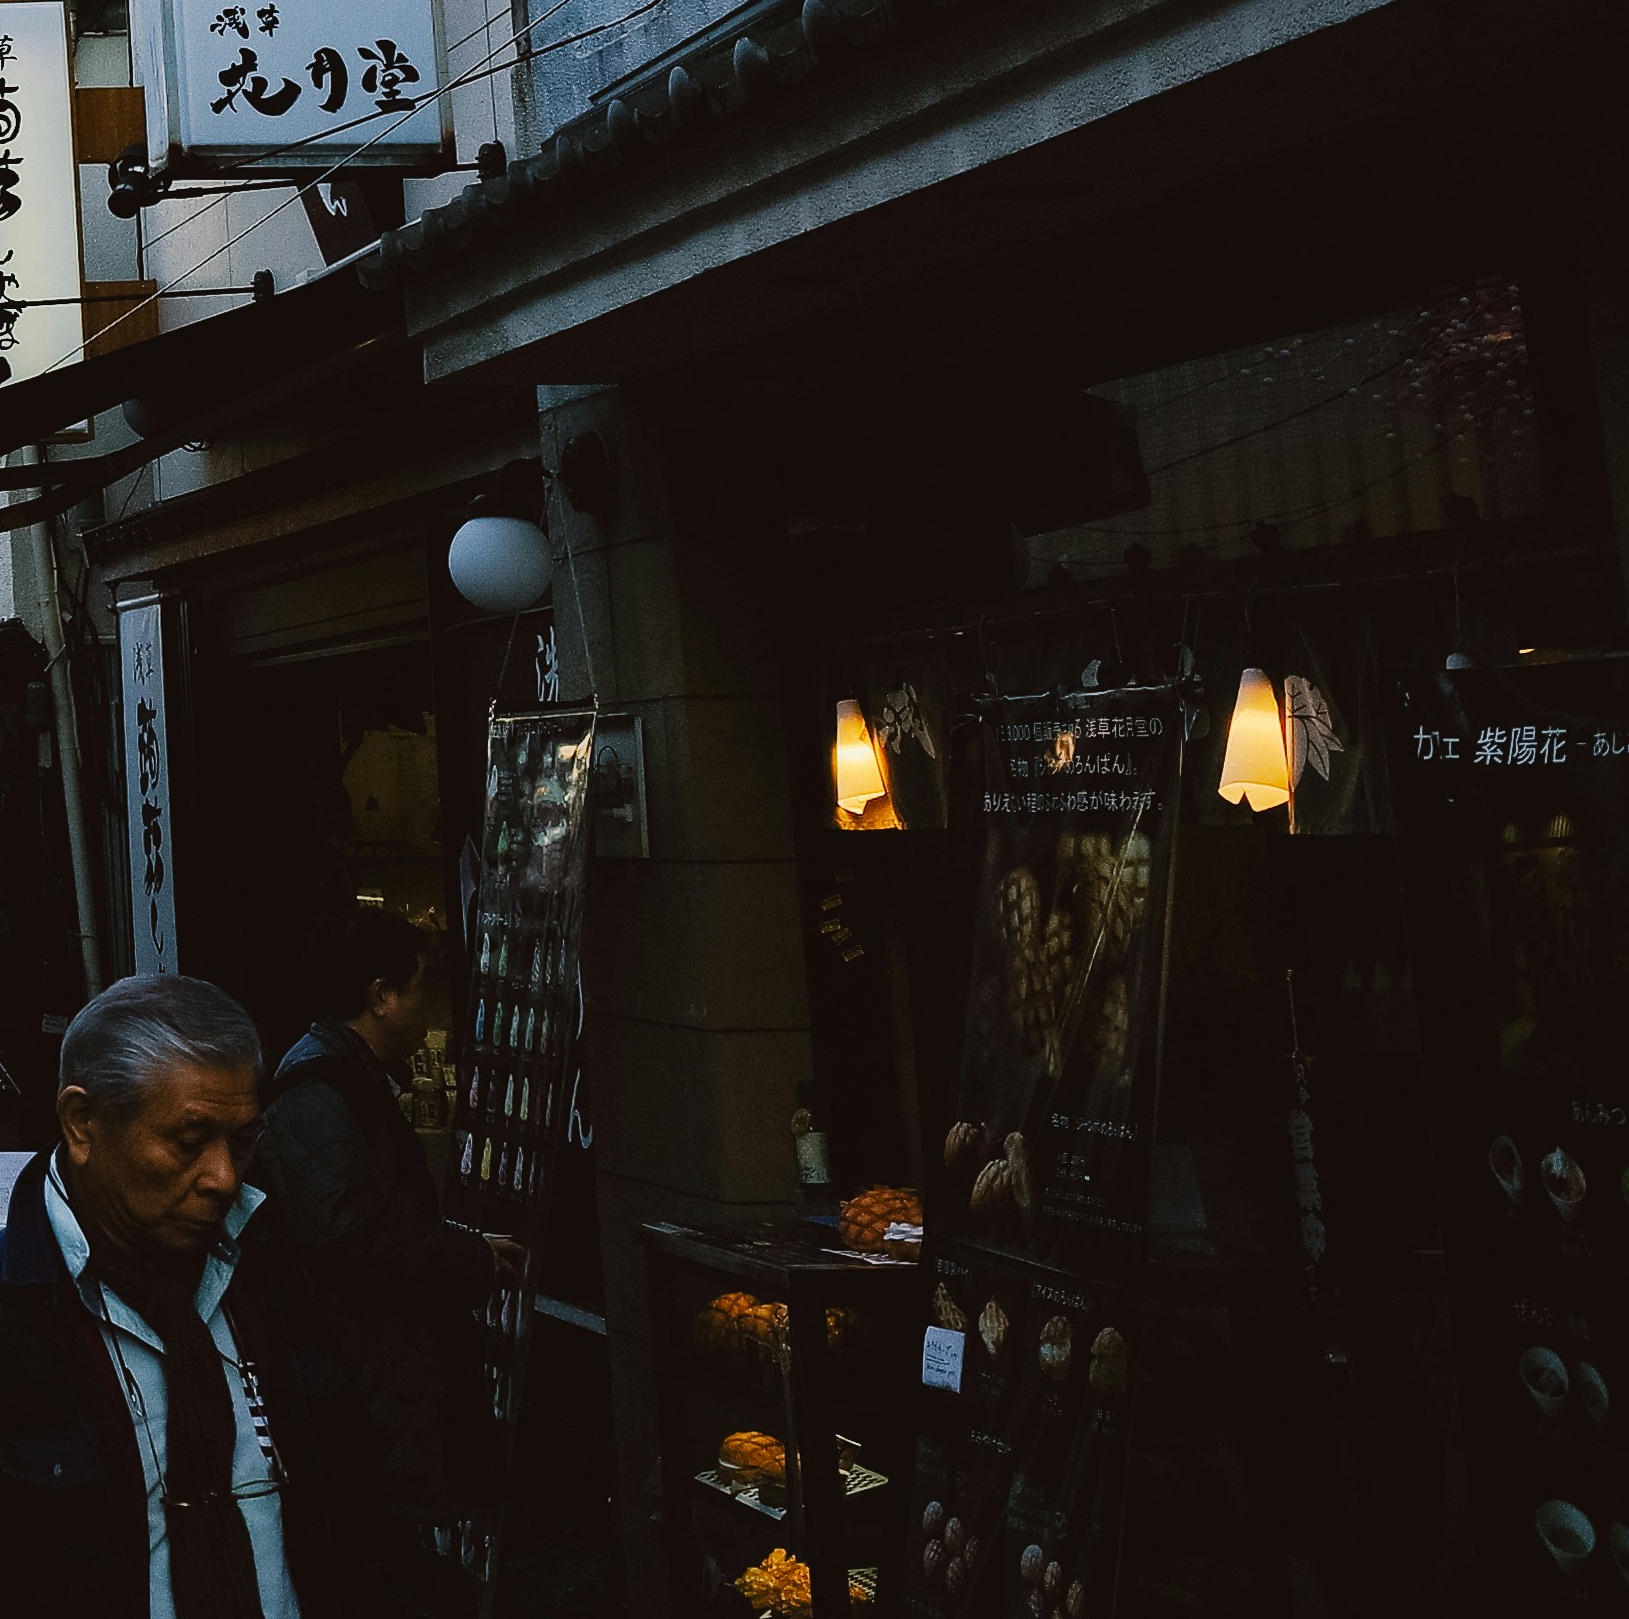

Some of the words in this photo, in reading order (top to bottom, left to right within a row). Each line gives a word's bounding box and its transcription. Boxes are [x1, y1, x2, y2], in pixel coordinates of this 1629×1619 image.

[211, 5, 282, 39] 浅草
[211, 40, 422, 118] 花月堂
[137, 696, 166, 973] 蒟蒻し
